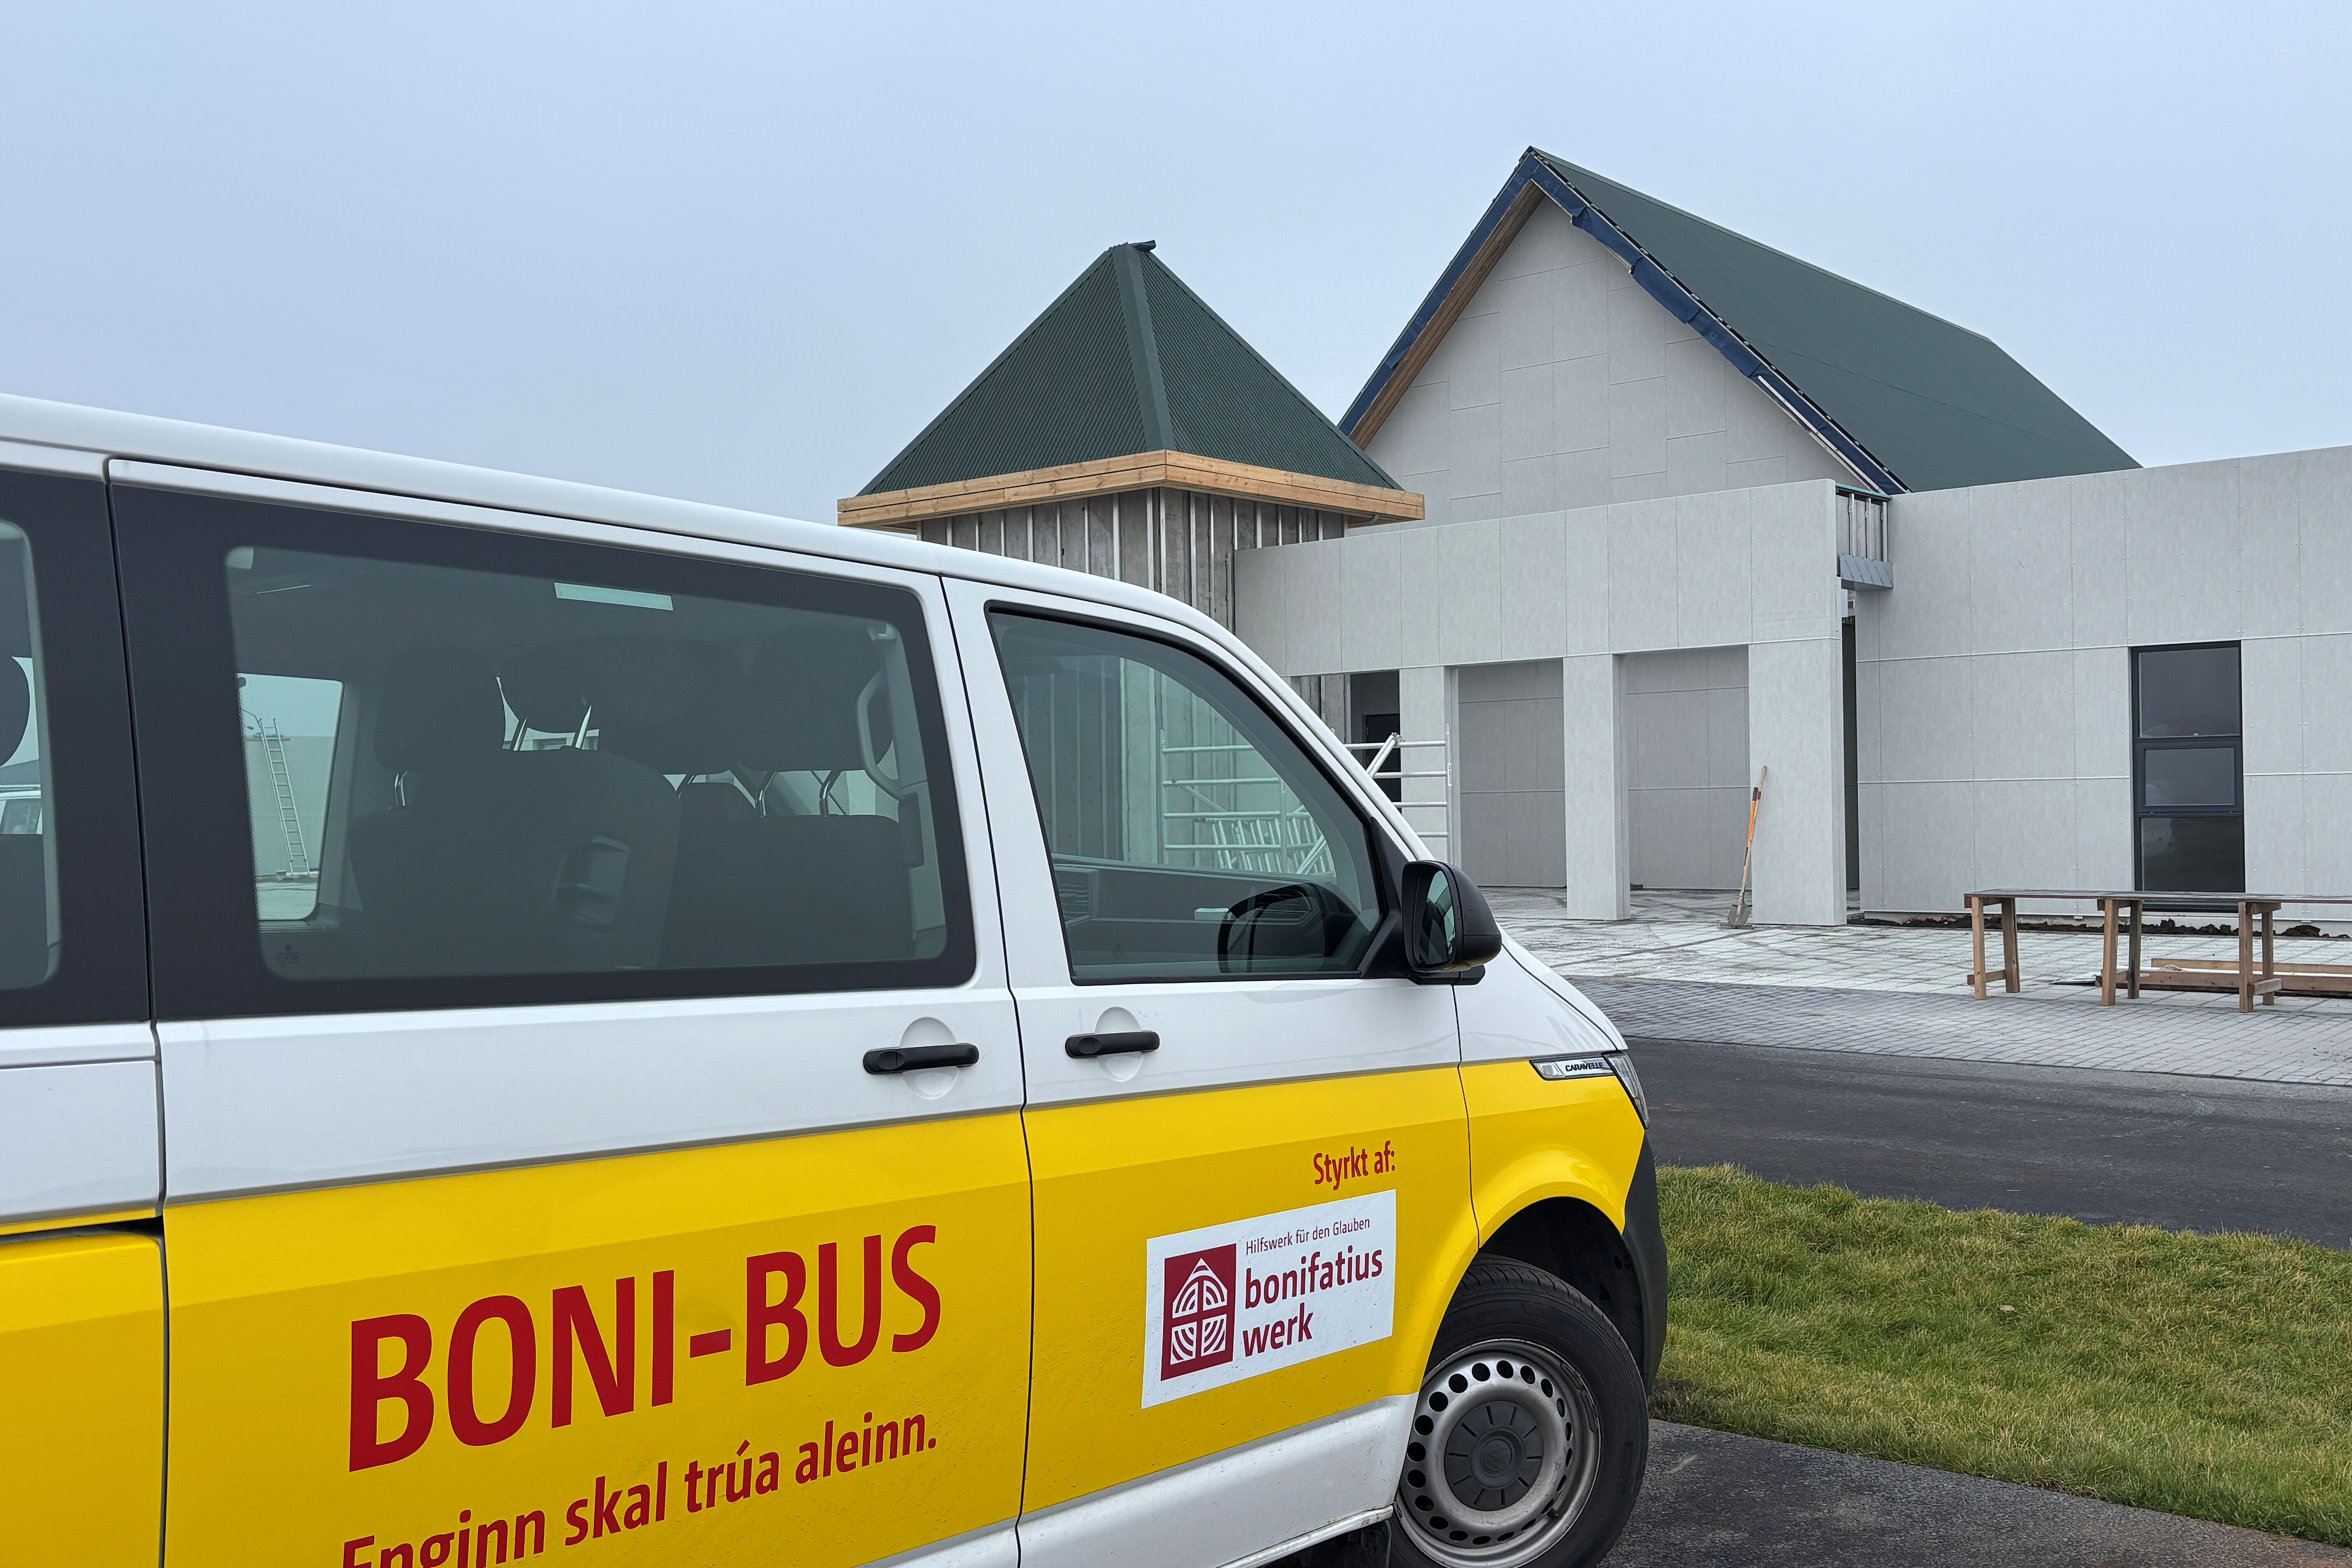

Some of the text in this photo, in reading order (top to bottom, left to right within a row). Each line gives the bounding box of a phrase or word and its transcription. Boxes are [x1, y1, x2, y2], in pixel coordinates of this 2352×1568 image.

[1565, 1062, 1604, 1072] CARAVELLE
[1313, 1140, 1395, 1191] Styrkt af:
[1246, 1218, 1370, 1256] Hilfswerk für den Glauben
[1245, 1245, 1383, 1309] bonifatius
[349, 1225, 941, 1472] BONI-BUS
[1242, 1302, 1314, 1357] werk
[565, 1461, 667, 1546] skal
[684, 1440, 779, 1513] trúa
[795, 1412, 936, 1484] aleinn.
